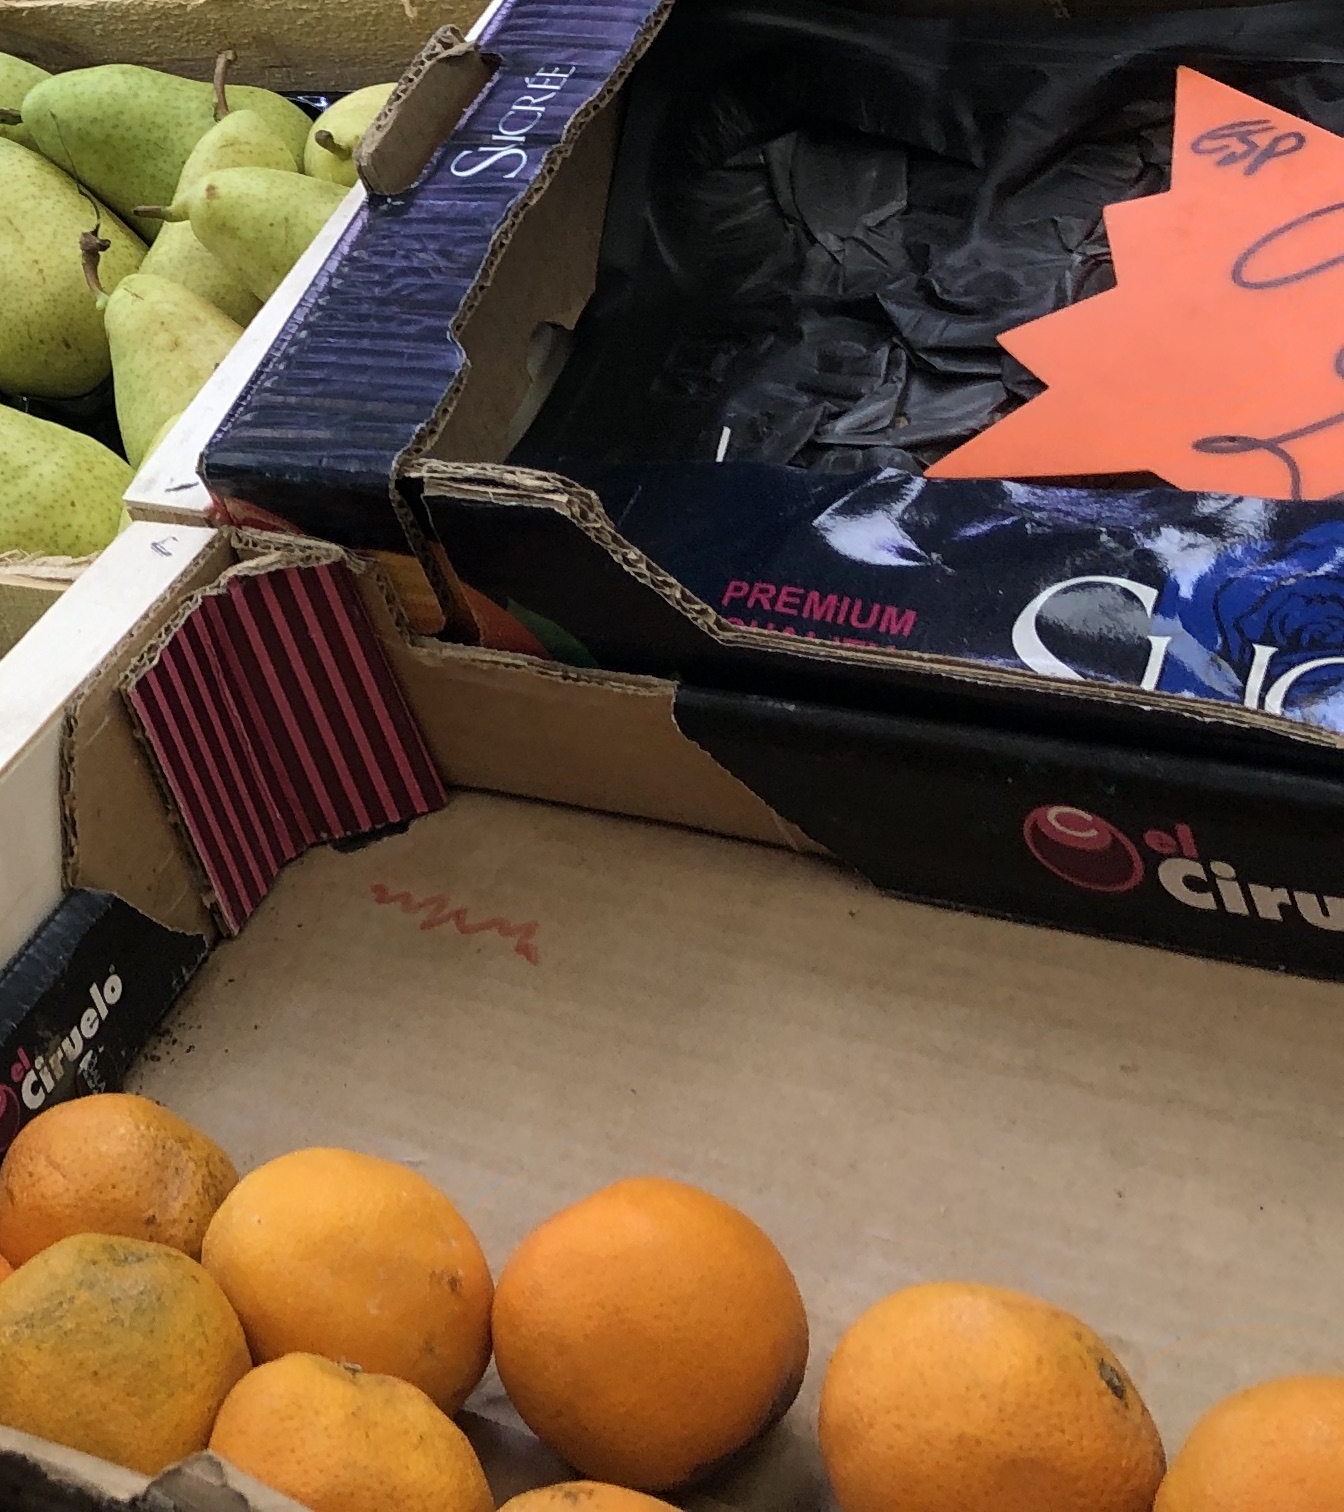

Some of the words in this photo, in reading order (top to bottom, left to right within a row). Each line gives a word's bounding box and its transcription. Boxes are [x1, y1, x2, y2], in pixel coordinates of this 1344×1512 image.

[720, 579, 918, 638] PREMIUM
[1143, 822, 1199, 858] el
[11, 1047, 32, 1083] el
